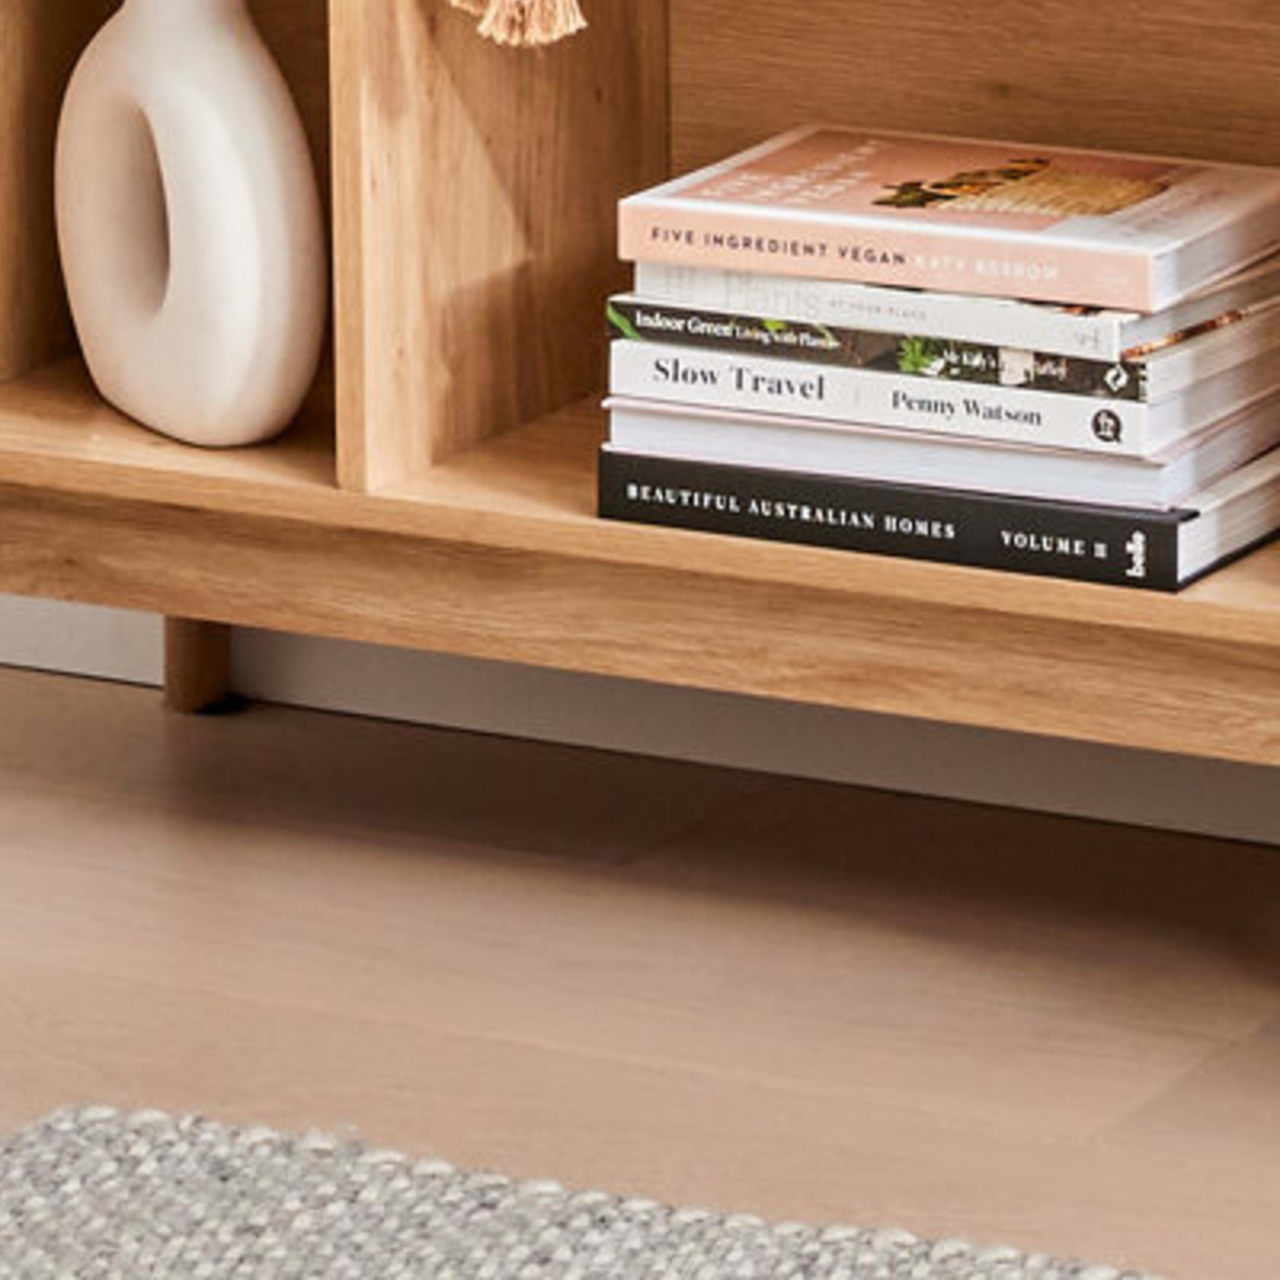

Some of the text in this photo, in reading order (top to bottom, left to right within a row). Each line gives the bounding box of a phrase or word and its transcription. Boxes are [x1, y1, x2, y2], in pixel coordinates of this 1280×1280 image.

[650, 226, 695, 246] FIVE
[703, 232, 828, 258] INGREDIENT
[837, 246, 907, 266] VEGAN
[634, 310, 686, 333] Indoor
[686, 314, 734, 338] Green
[652, 357, 1043, 427] Slow Travel Penny Watson
[626, 482, 741, 513] BEAUTIFUL
[747, 498, 875, 530] AUSTRALIAN
[884, 514, 956, 540] HOMES
[1000, 529, 1086, 556] VOLUME
